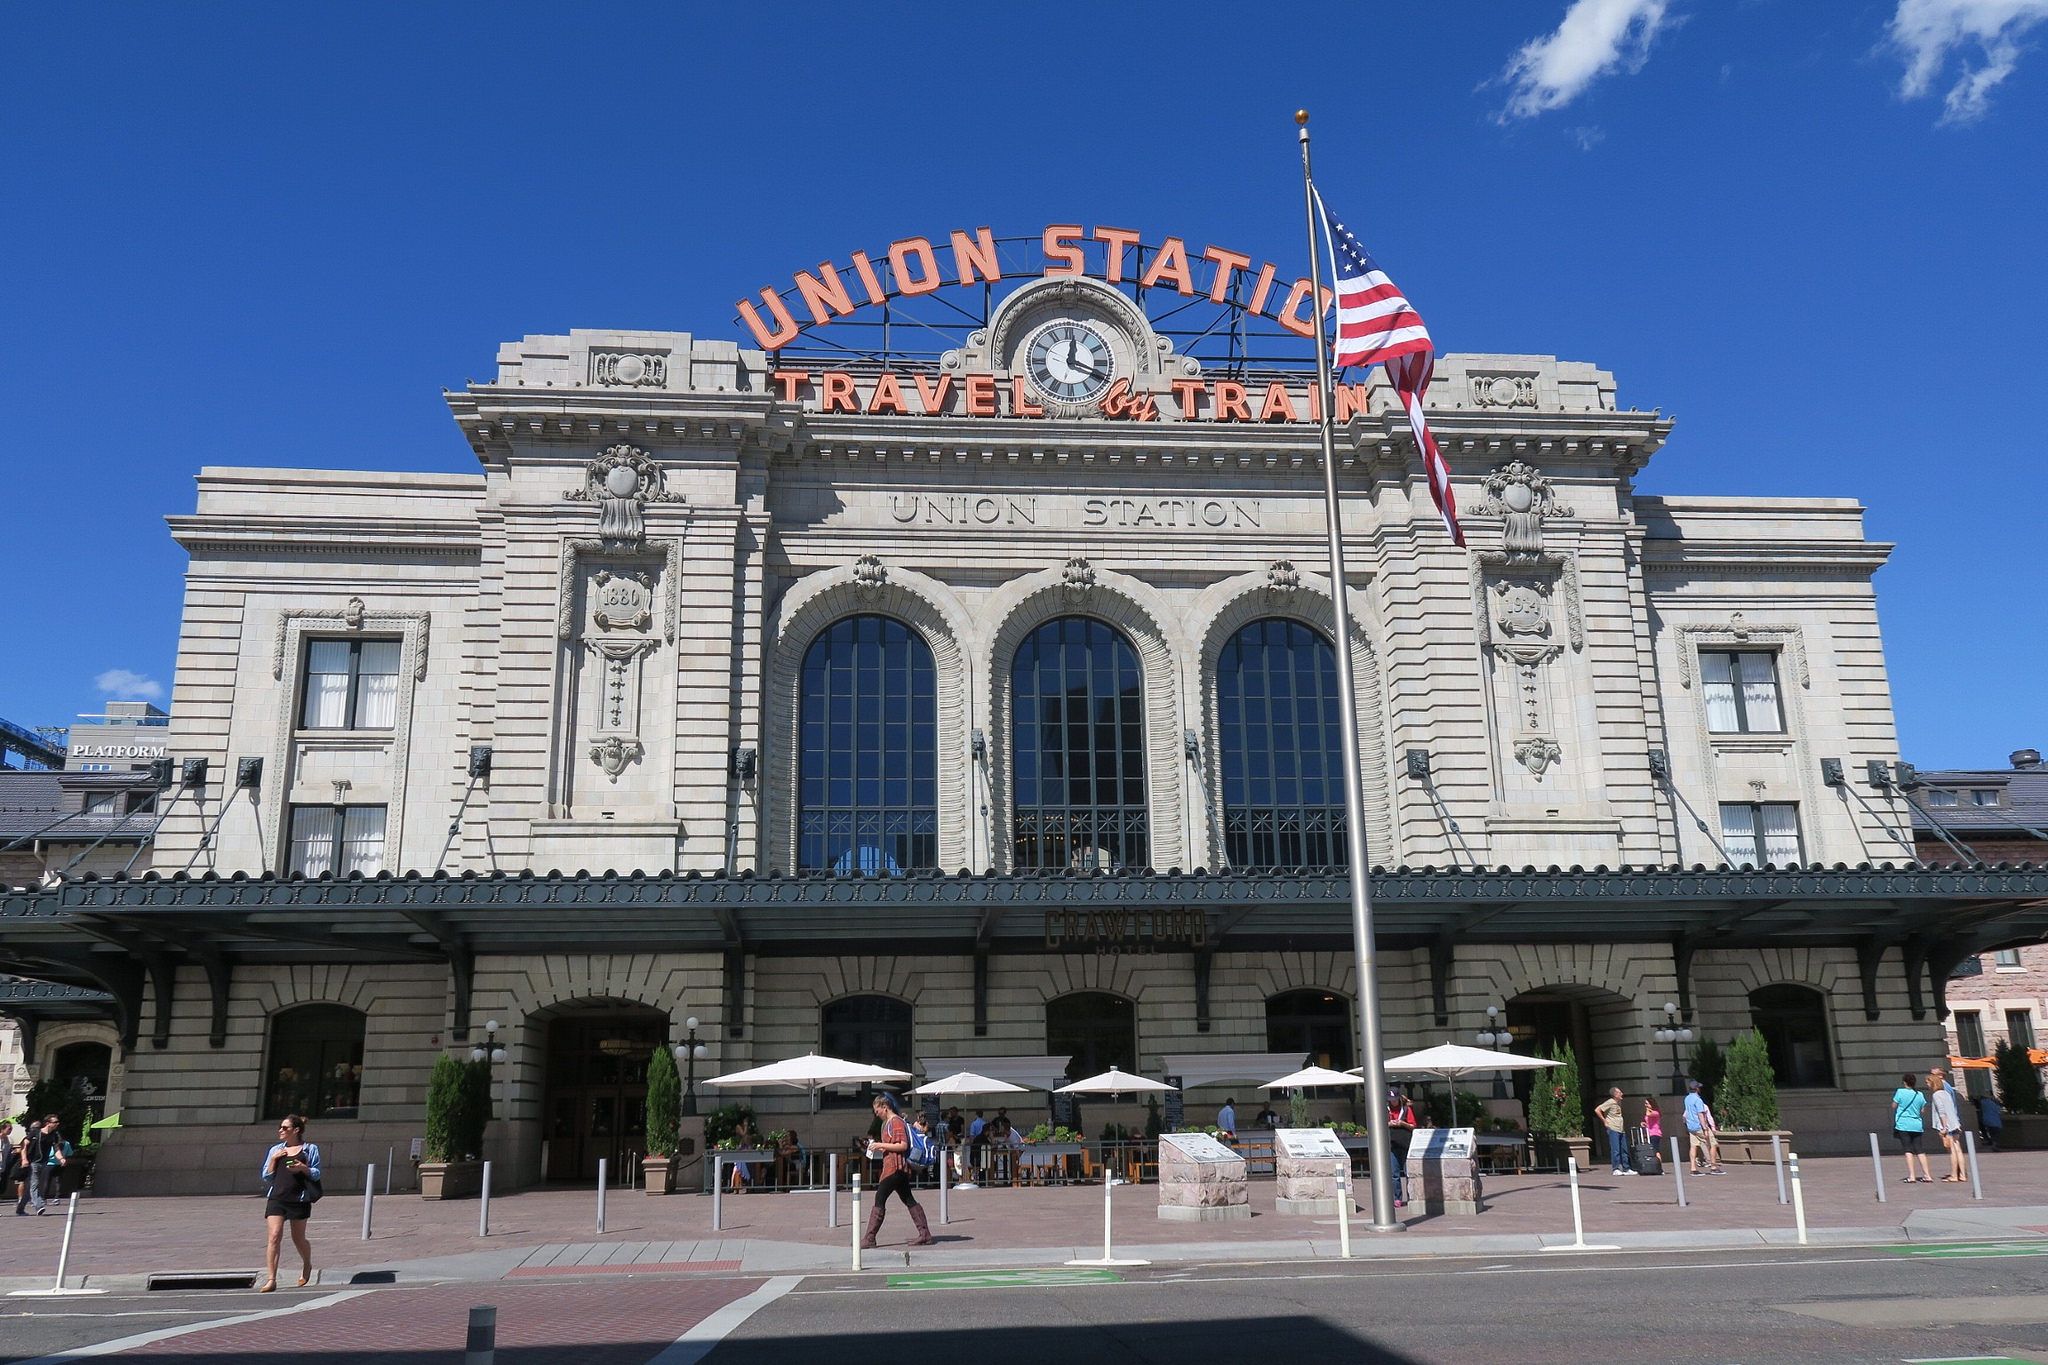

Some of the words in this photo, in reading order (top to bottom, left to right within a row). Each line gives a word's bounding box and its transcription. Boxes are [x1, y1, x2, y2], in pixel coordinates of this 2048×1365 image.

[735, 225, 1000, 350] UNION
[1043, 224, 1336, 340] STATIO
[774, 369, 1043, 417] TRAVEL
[1100, 377, 1159, 421] by
[1172, 378, 1370, 424] TRAIN
[889, 496, 1035, 525] UNION
[1084, 499, 1260, 527] STATION
[73, 745, 166, 758] PLATFORM
[1045, 909, 1206, 948] CRAWFORD
[1096, 945, 1159, 956] HOTEL
